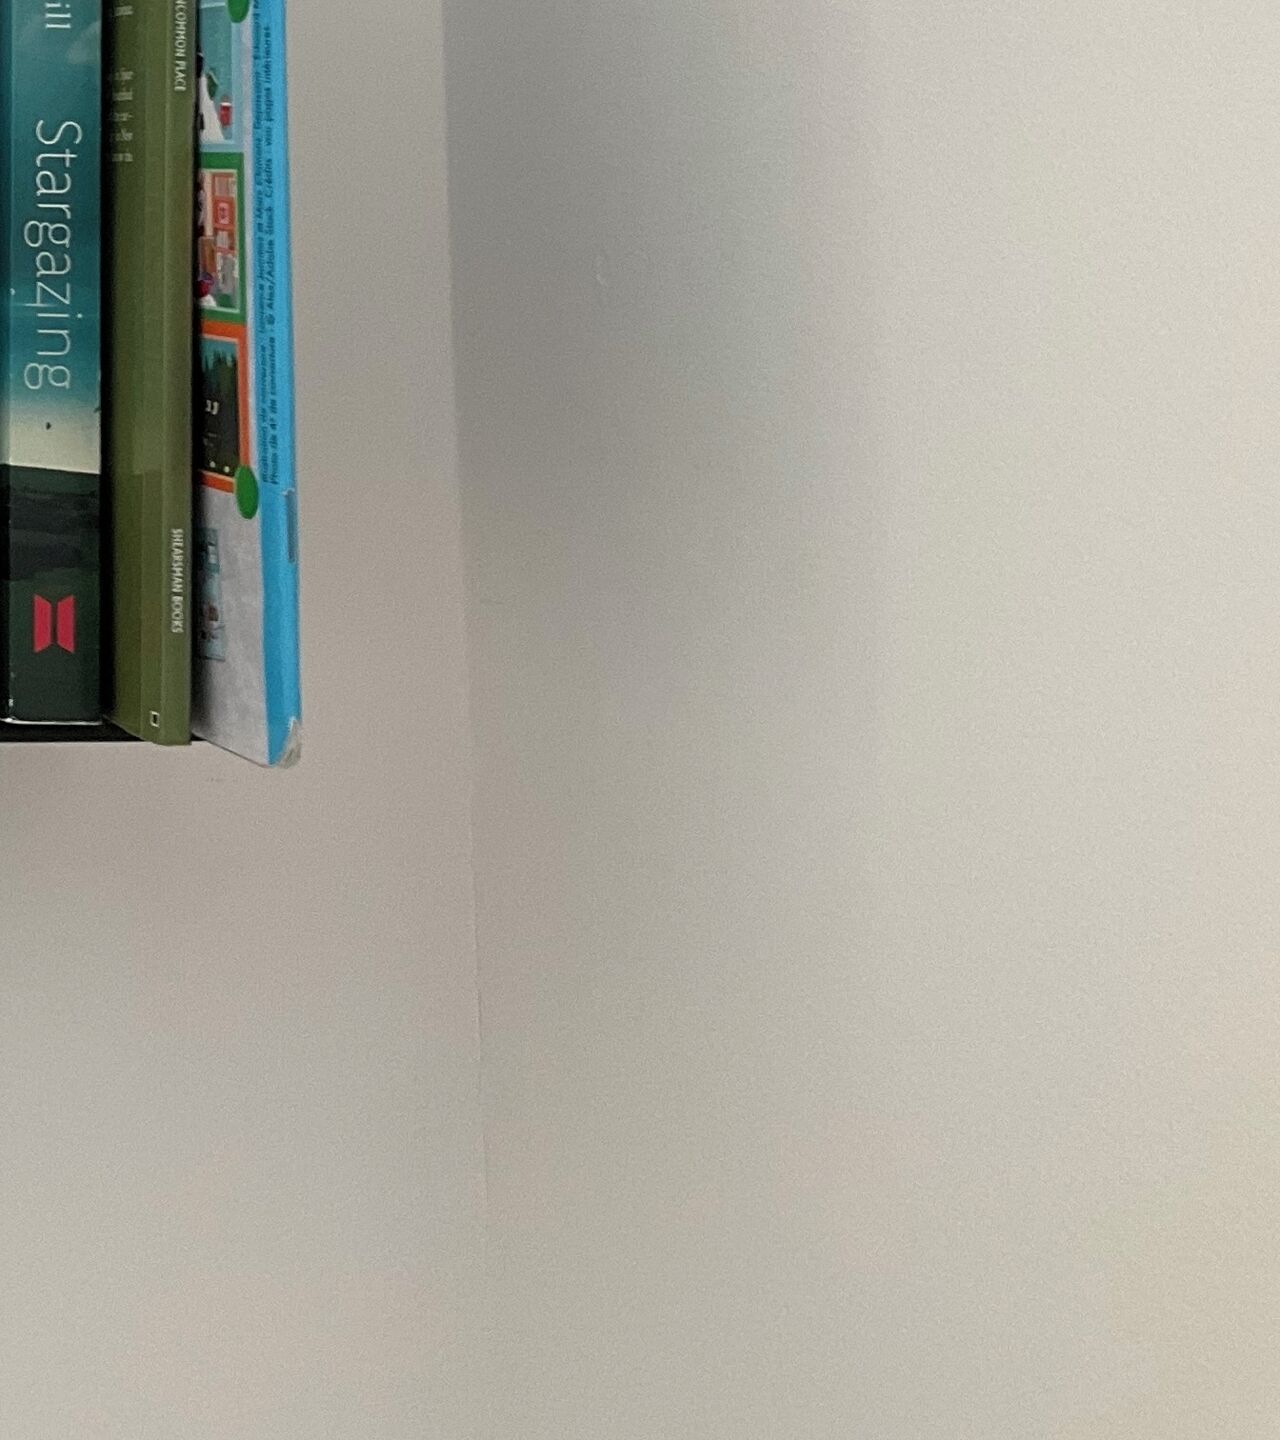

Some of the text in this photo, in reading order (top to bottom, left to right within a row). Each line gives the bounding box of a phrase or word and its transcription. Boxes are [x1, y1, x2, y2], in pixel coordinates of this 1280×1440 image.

[175, 60, 187, 92] PLACE
[23, 118, 84, 390] Stargazing
[171, 529, 183, 633] SHEARSMAN BOOKS
